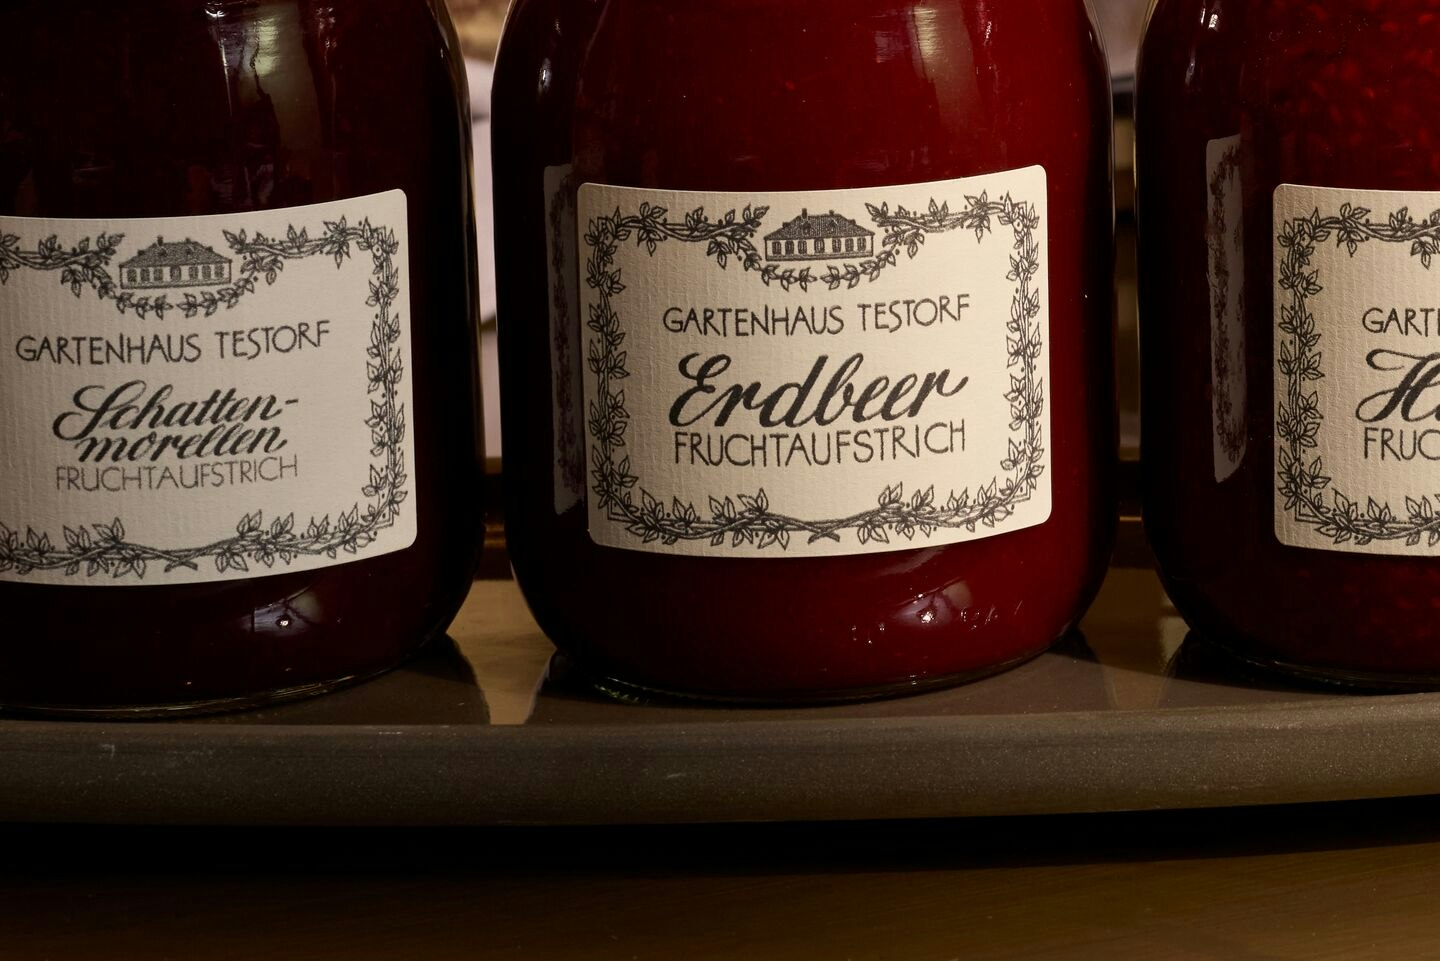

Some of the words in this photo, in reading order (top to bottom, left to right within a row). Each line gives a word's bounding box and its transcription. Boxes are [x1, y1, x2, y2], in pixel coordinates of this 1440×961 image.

[663, 304, 844, 337] GARTENHAUS
[857, 293, 970, 333] TESTORF
[15, 333, 201, 365] GARTENHAUS
[215, 319, 330, 360] TESTORF
[52, 380, 299, 441] Schatten-
[668, 351, 969, 428] Erdbeer
[75, 422, 288, 462] morellen
[674, 419, 967, 467] FRUCHTAUFSTRICH
[56, 454, 298, 492] FRUCHTAUFSTRICH
